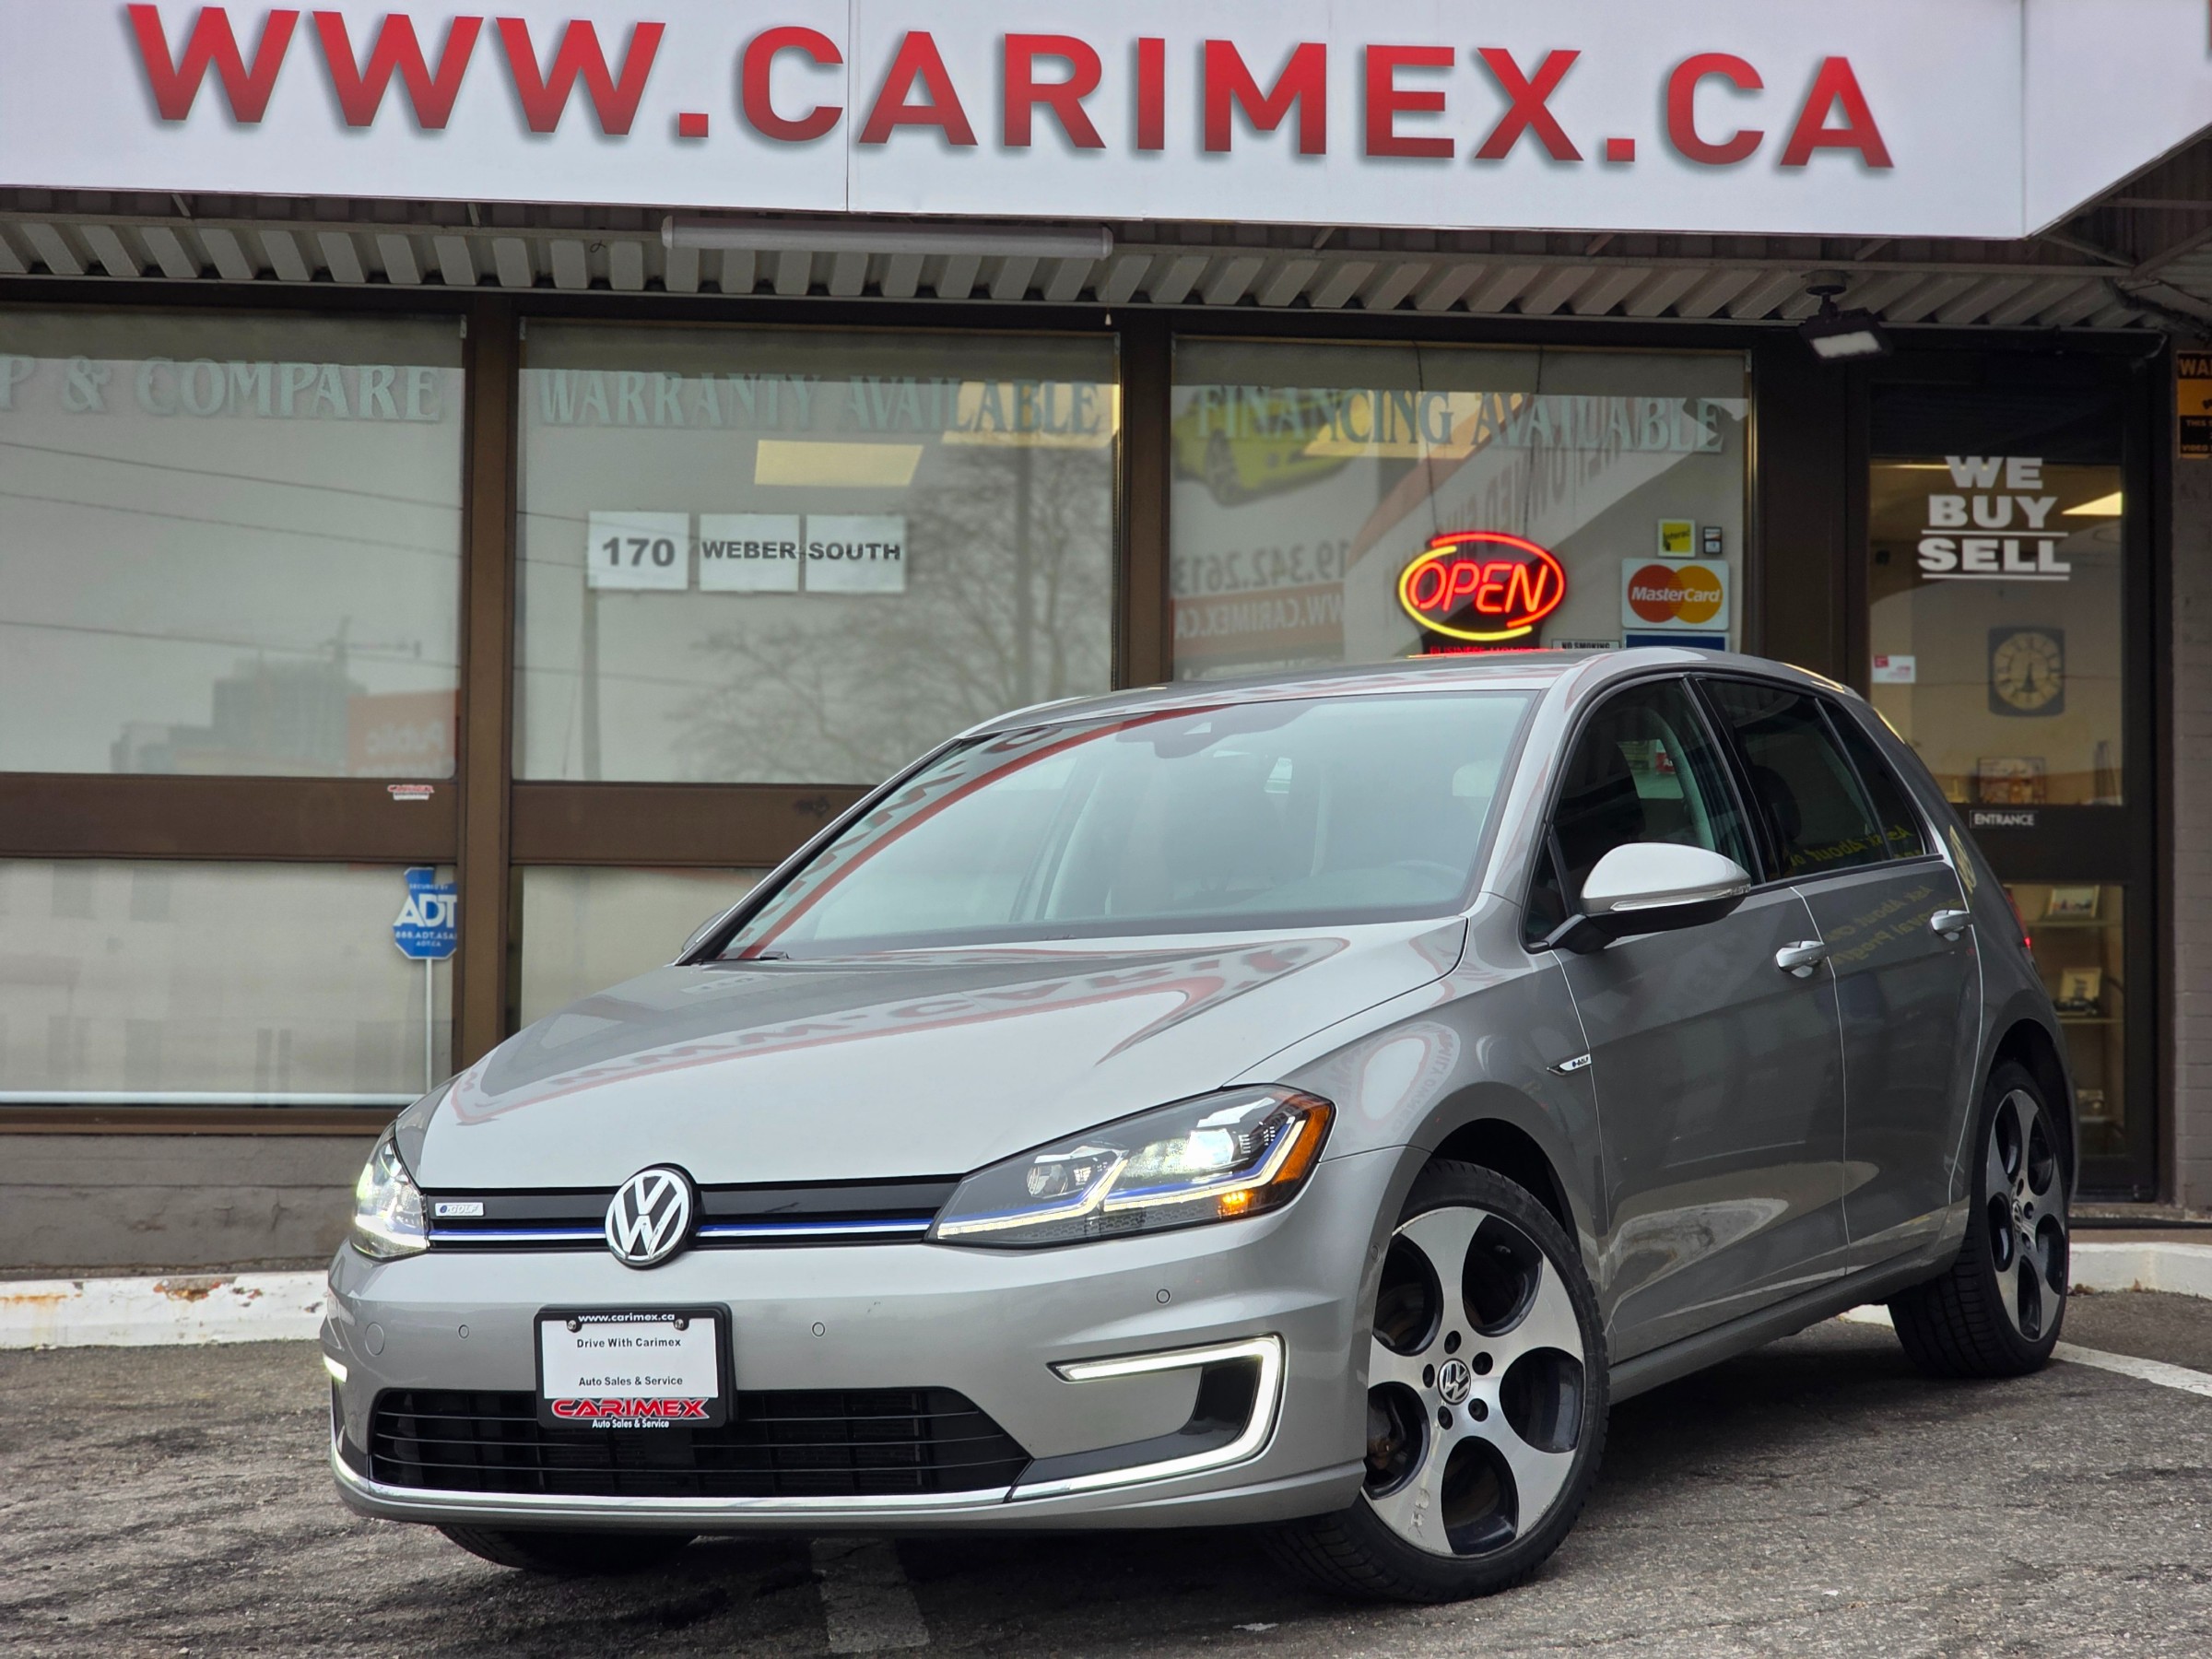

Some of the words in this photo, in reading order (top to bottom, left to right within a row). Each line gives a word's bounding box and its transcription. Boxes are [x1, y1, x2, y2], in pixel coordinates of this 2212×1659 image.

[128, 3, 1894, 170] WWW.CARIMEX.CA
[2180, 359, 2212, 376] WA
[61, 355, 112, 414] &
[135, 357, 443, 423] COMPARE
[539, 371, 821, 428] WARRANTY
[847, 375, 1101, 434] AVAILABLE
[1195, 385, 1455, 446] FINANCING
[1470, 393, 1724, 453] AVAILABLE
[1945, 455, 2043, 489] WE
[1928, 494, 2057, 529] BUY
[602, 537, 675, 567] 170
[701, 540, 796, 559] WEBER
[808, 541, 900, 560] SOUTH
[1917, 538, 2071, 572] SELL
[1407, 560, 1549, 614] OPEN
[1630, 586, 1721, 603] MasterCard
[1974, 813, 2034, 826] ENTRANCE
[393, 893, 457, 929] ADT
[578, 1312, 675, 1323] www.carimex.ca
[577, 1338, 605, 1348] Drive
[608, 1338, 632, 1347] With
[636, 1338, 681, 1347] Carimex
[579, 1378, 602, 1386] Auto
[605, 1377, 631, 1386] Sales
[635, 1377, 641, 1385] &
[645, 1376, 682, 1385] Service
[552, 1398, 710, 1418] CARIMEX
[592, 1419, 610, 1428] Auto
[612, 1419, 633, 1428] Sales
[634, 1419, 641, 1428] &
[642, 1419, 669, 1428] Service
